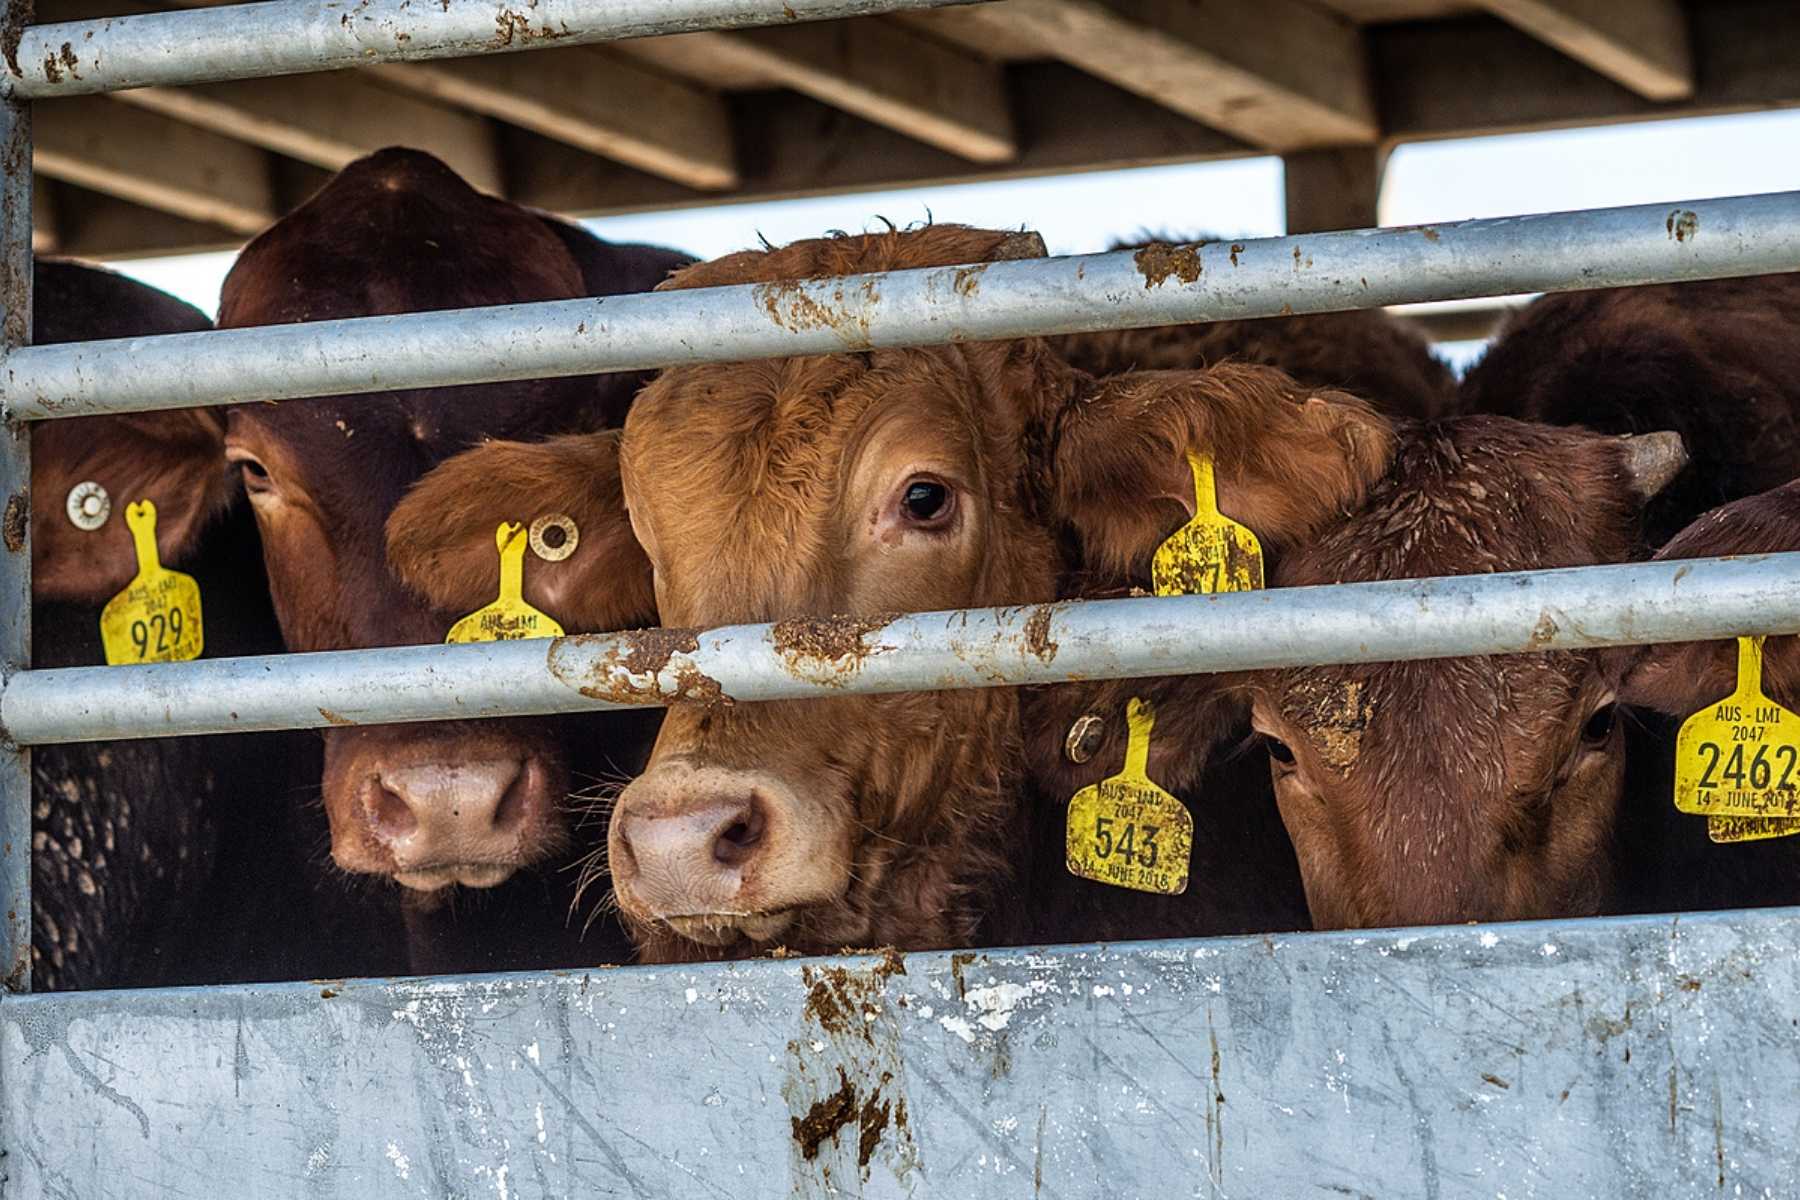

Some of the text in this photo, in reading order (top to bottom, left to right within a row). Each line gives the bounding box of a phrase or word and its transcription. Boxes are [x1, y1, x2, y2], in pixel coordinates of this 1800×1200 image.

[131, 606, 183, 658] 929
[1716, 705, 1743, 722] AUS
[1755, 706, 1781, 724] LMI
[1732, 725, 1765, 742] 2047
[1697, 741, 1799, 791] 2462
[1101, 783, 1125, 801] AUS
[1725, 790, 1759, 808] JUNE
[1114, 802, 1144, 820] 2047
[1094, 816, 1160, 868] 543
[1106, 863, 1137, 881] JUNE
